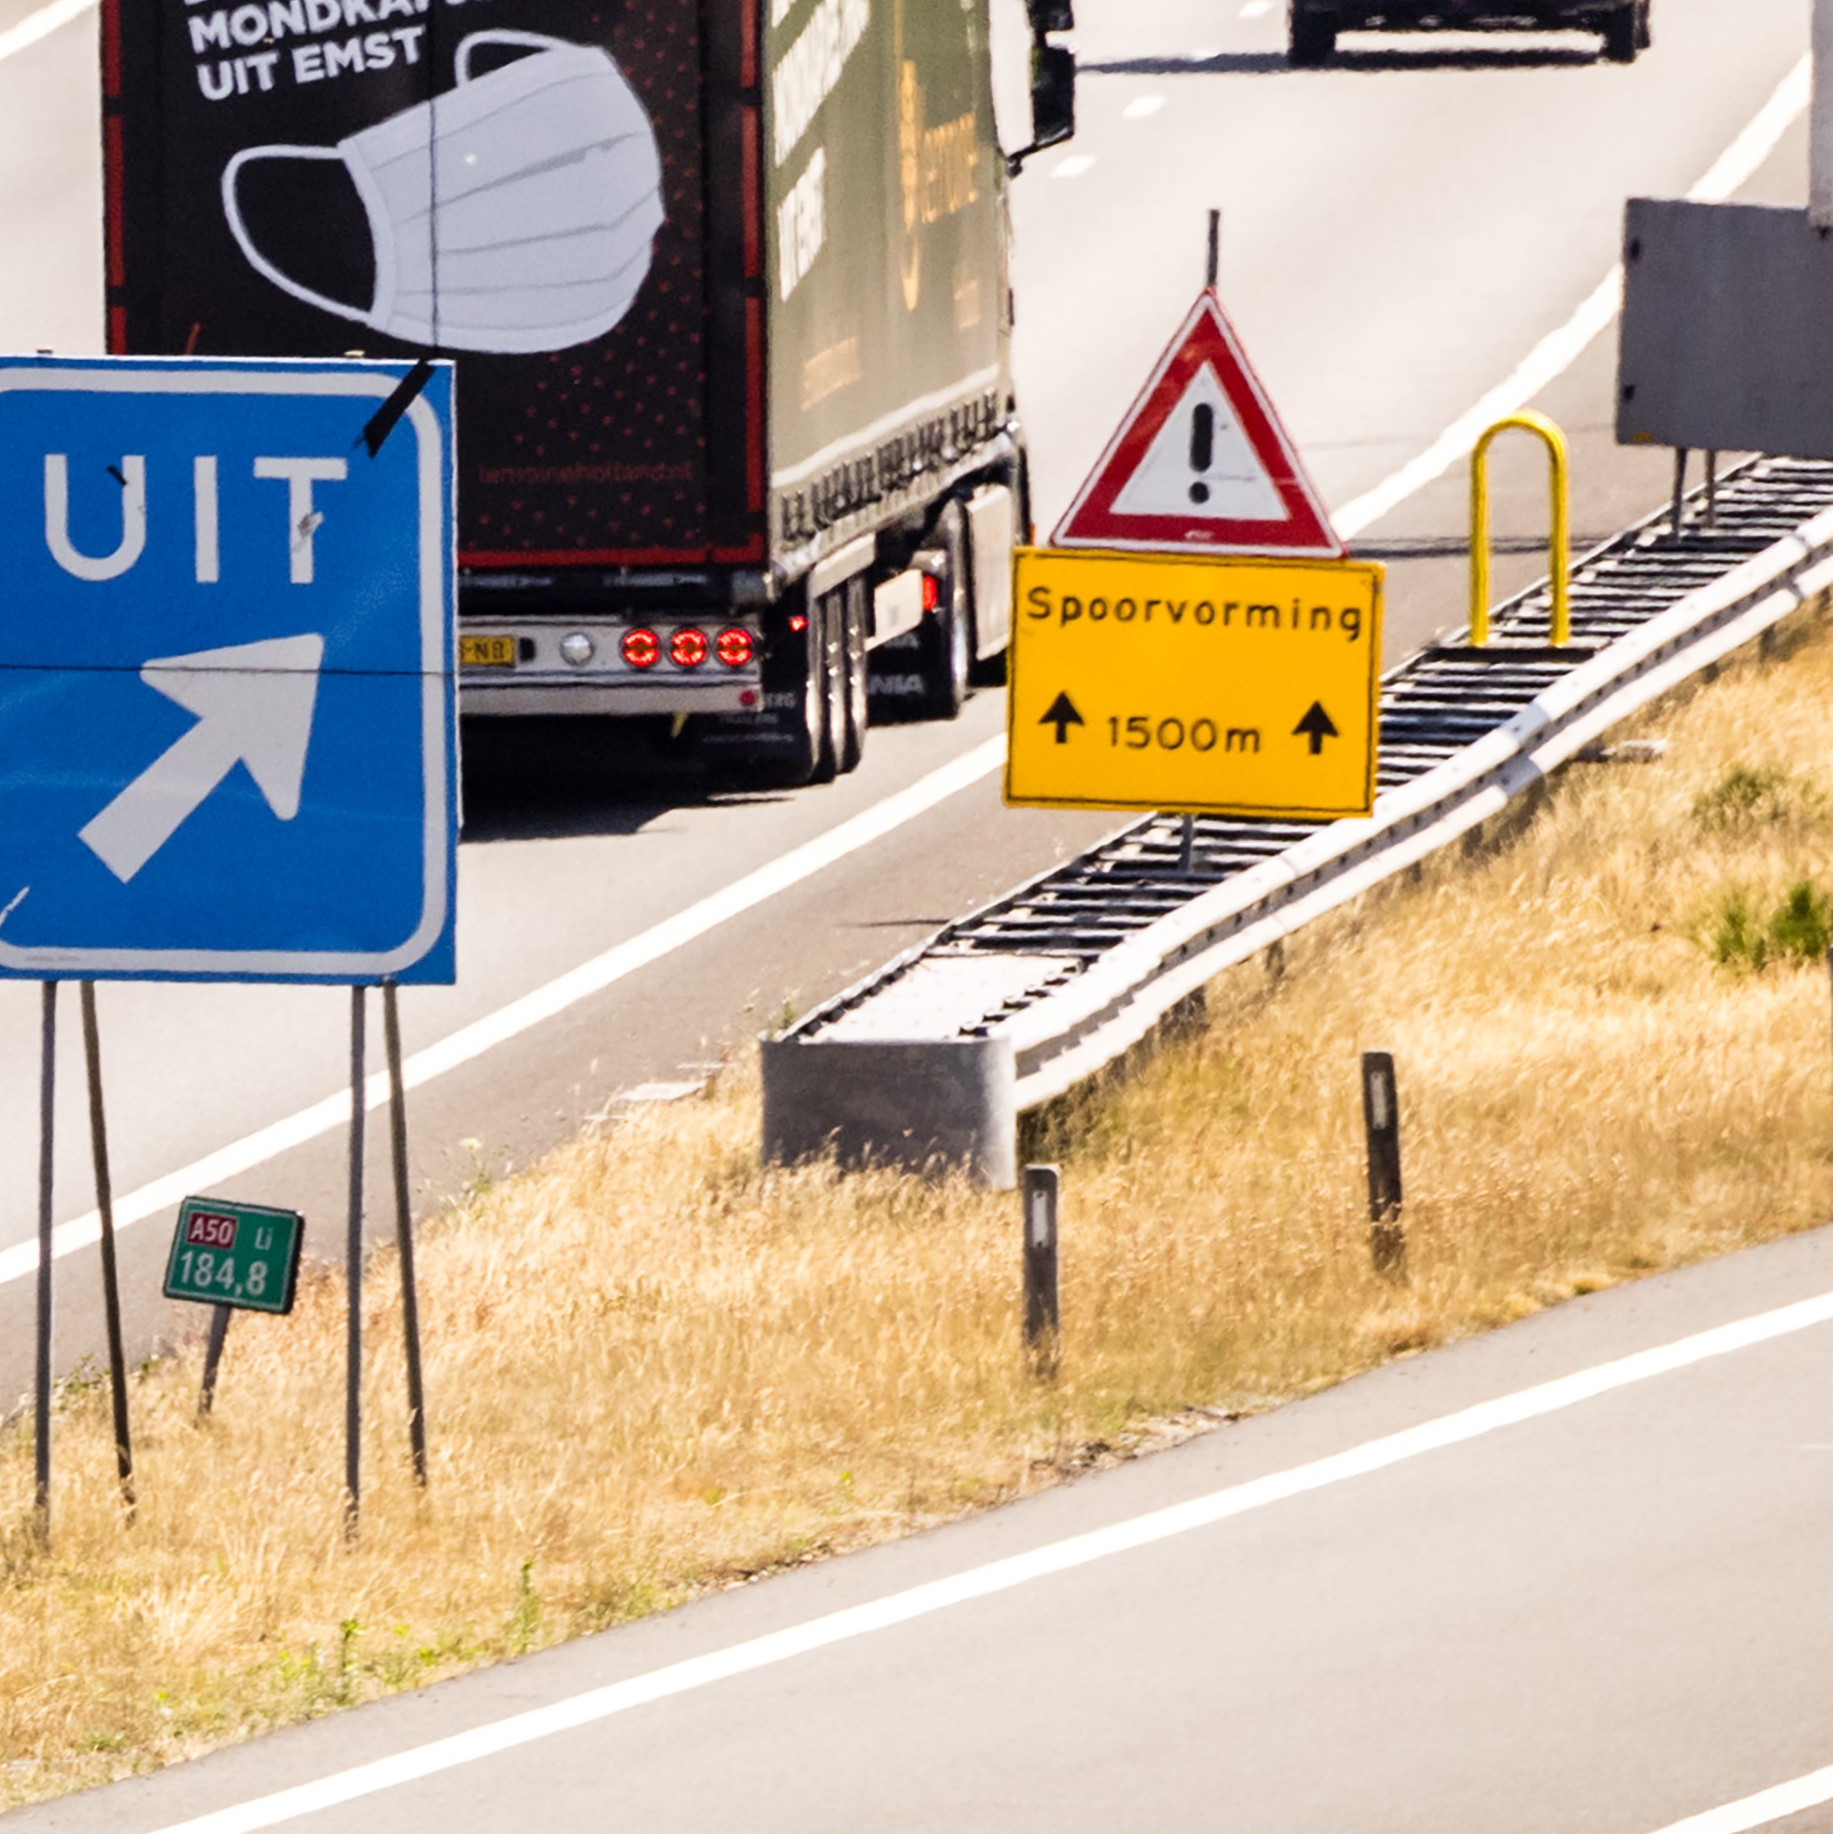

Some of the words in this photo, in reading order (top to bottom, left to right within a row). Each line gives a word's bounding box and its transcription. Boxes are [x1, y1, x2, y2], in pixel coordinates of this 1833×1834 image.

[197, 52, 280, 101] UIT
[292, 25, 426, 85] EMST
[44, 453, 348, 585] UIT
[1027, 585, 1363, 642] Spoorvorming
[1108, 716, 1261, 754] 1500m
[190, 1218, 234, 1245] A50
[255, 1226, 275, 1250] Li
[181, 1251, 269, 1297] 184,8
